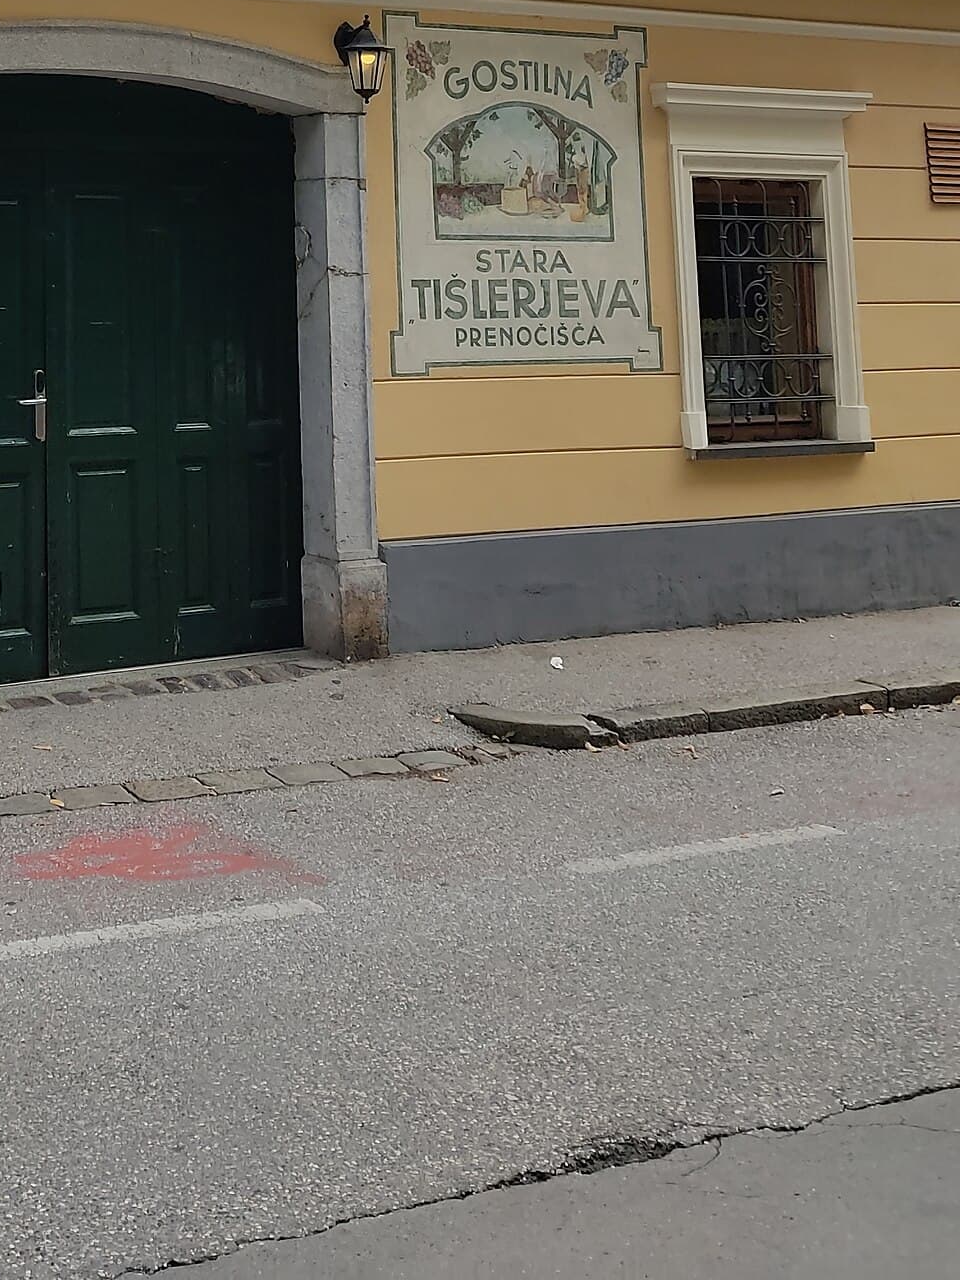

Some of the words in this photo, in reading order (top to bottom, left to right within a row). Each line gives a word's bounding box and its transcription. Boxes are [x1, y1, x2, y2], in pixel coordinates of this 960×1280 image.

[443, 59, 594, 109] GOSTILNA
[475, 249, 573, 274] STARA
[455, 322, 605, 348] PRENOČIŠČA
